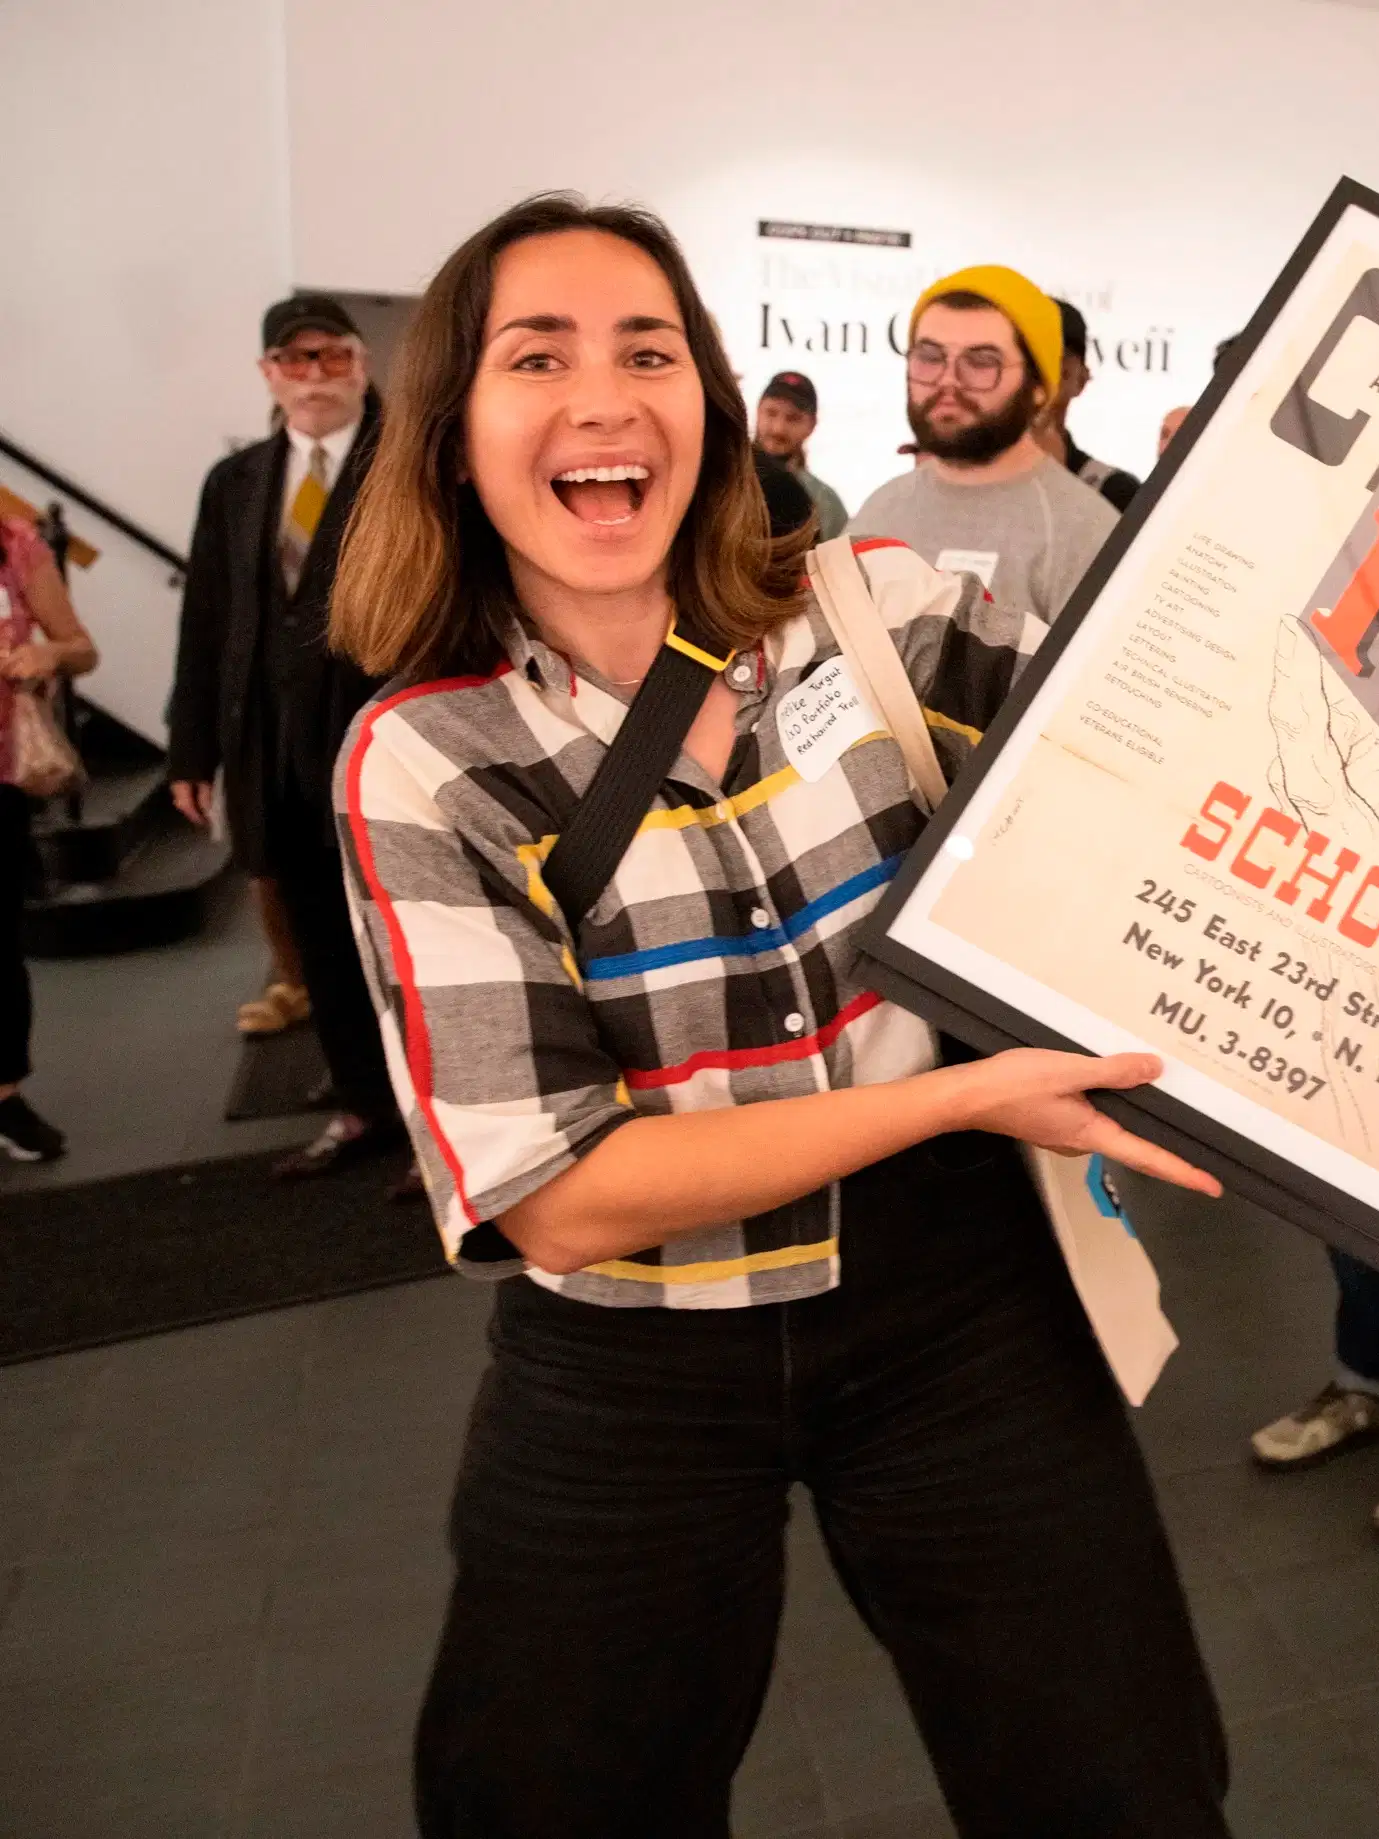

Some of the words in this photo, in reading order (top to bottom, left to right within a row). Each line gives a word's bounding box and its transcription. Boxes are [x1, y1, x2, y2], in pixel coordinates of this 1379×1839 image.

[760, 303, 868, 353] Ivan
[1185, 544, 1228, 572] ANATOMY
[1193, 532, 1212, 546] LIFE
[1214, 543, 1256, 569] DRAWING
[1168, 568, 1211, 596] PAINTING
[1177, 557, 1237, 593] ILLUSTRATION
[1154, 593, 1166, 604] TV
[1166, 600, 1185, 613] ART
[1160, 581, 1221, 618] CARTOONING
[1129, 633, 1177, 663] LETTERING
[1136, 620, 1172, 641] LAYOUT
[1144, 608, 1203, 643] ADVERTISING
[1203, 640, 1237, 661] DESIGN
[1104, 673, 1163, 709] RETOUCHING
[1112, 660, 1129, 673] AIR
[1130, 669, 1161, 689] BRUSH
[1164, 687, 1213, 718] RENDERING
[1121, 646, 1168, 678] TECHNICAL
[1171, 675, 1232, 712] ILLUSTRATION
[1079, 714, 1124, 743] VETERANS
[1126, 739, 1165, 765] ELIGIBLE
[1086, 700, 1163, 747] CO-EDUCATIONAL
[1135, 879, 1197, 924] 245
[1203, 913, 1263, 963] East
[1269, 951, 1340, 1002] 23rd
[1184, 863, 1264, 913] CARTOONISTS
[1264, 909, 1293, 928] AND
[1295, 925, 1377, 975] ILLUSTRATORS
[1122, 921, 1184, 971] New
[1195, 958, 1253, 1010] York
[1334, 1036, 1364, 1075] N.
[1149, 992, 1207, 1043] MU.
[1217, 1030, 1327, 1102] 3-8397
